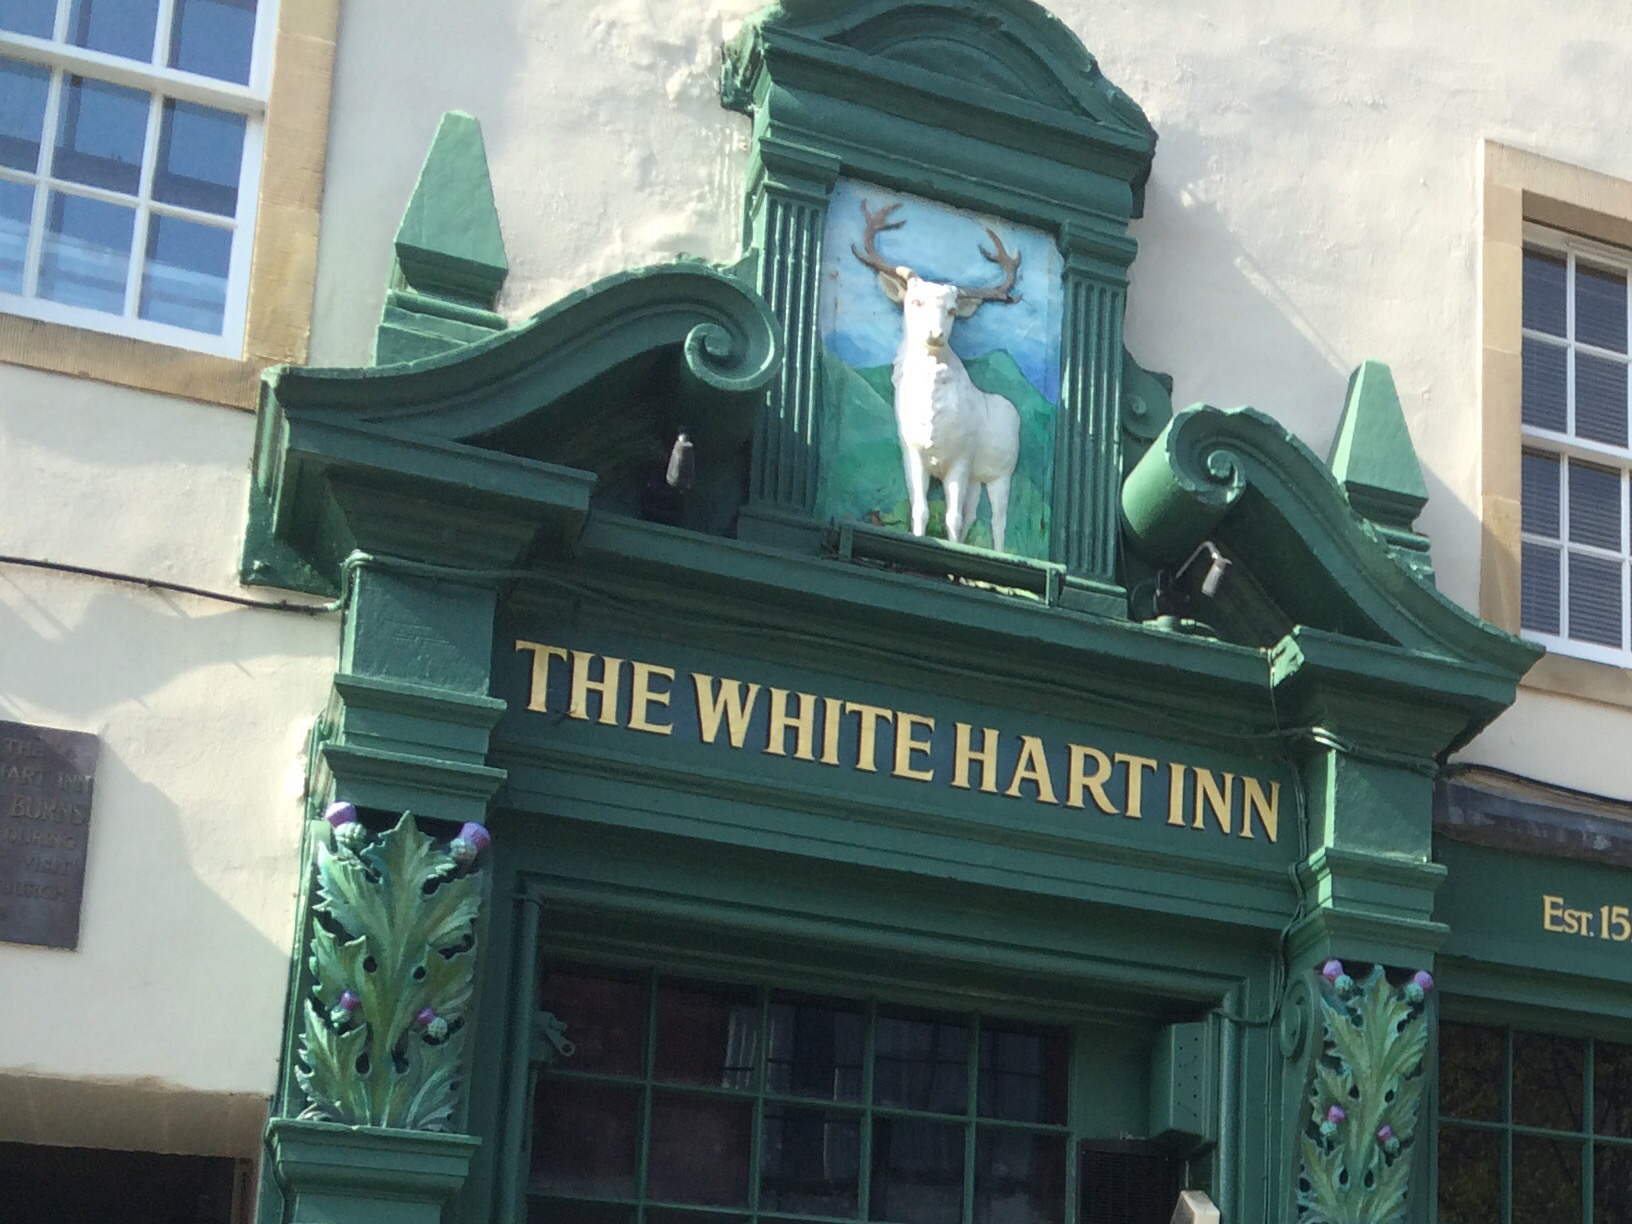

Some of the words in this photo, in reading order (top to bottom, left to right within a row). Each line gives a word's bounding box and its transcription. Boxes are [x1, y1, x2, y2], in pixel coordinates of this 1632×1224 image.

[514, 639, 675, 736] THE
[691, 671, 936, 782] WHITE
[951, 722, 1157, 820] HART
[1166, 761, 1282, 845] INN
